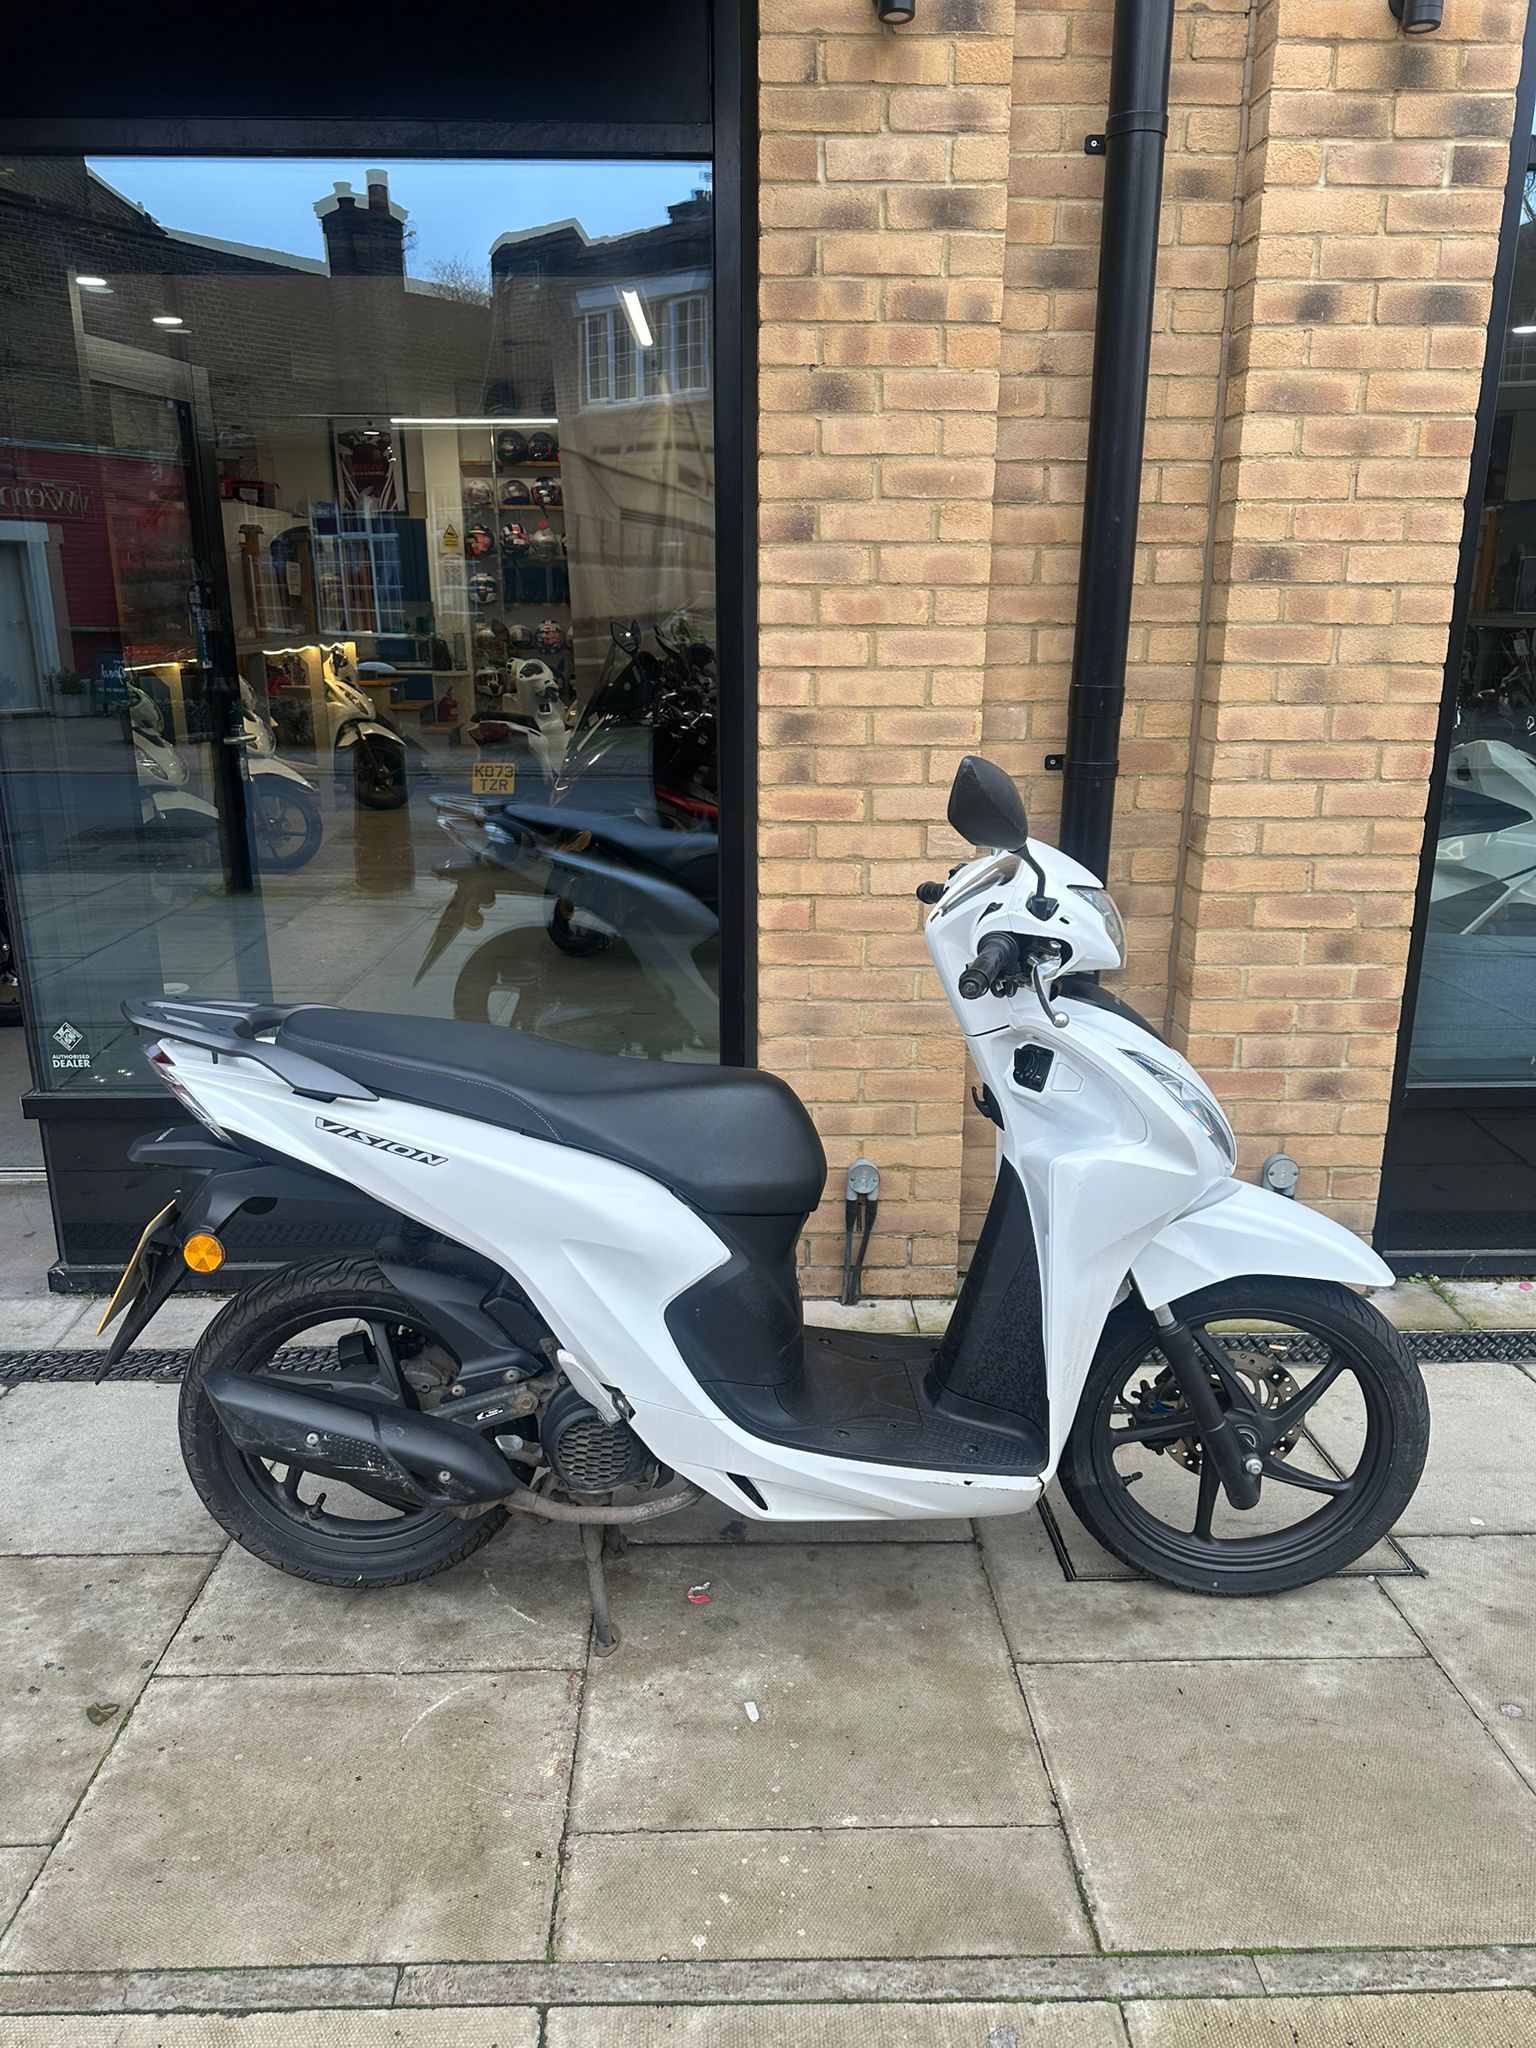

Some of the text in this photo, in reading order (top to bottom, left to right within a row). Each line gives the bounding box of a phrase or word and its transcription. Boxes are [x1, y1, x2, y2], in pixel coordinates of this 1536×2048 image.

[479, 779, 508, 791] TZR
[52, 1059, 91, 1068] DEALER
[315, 1116, 448, 1166] VISION
